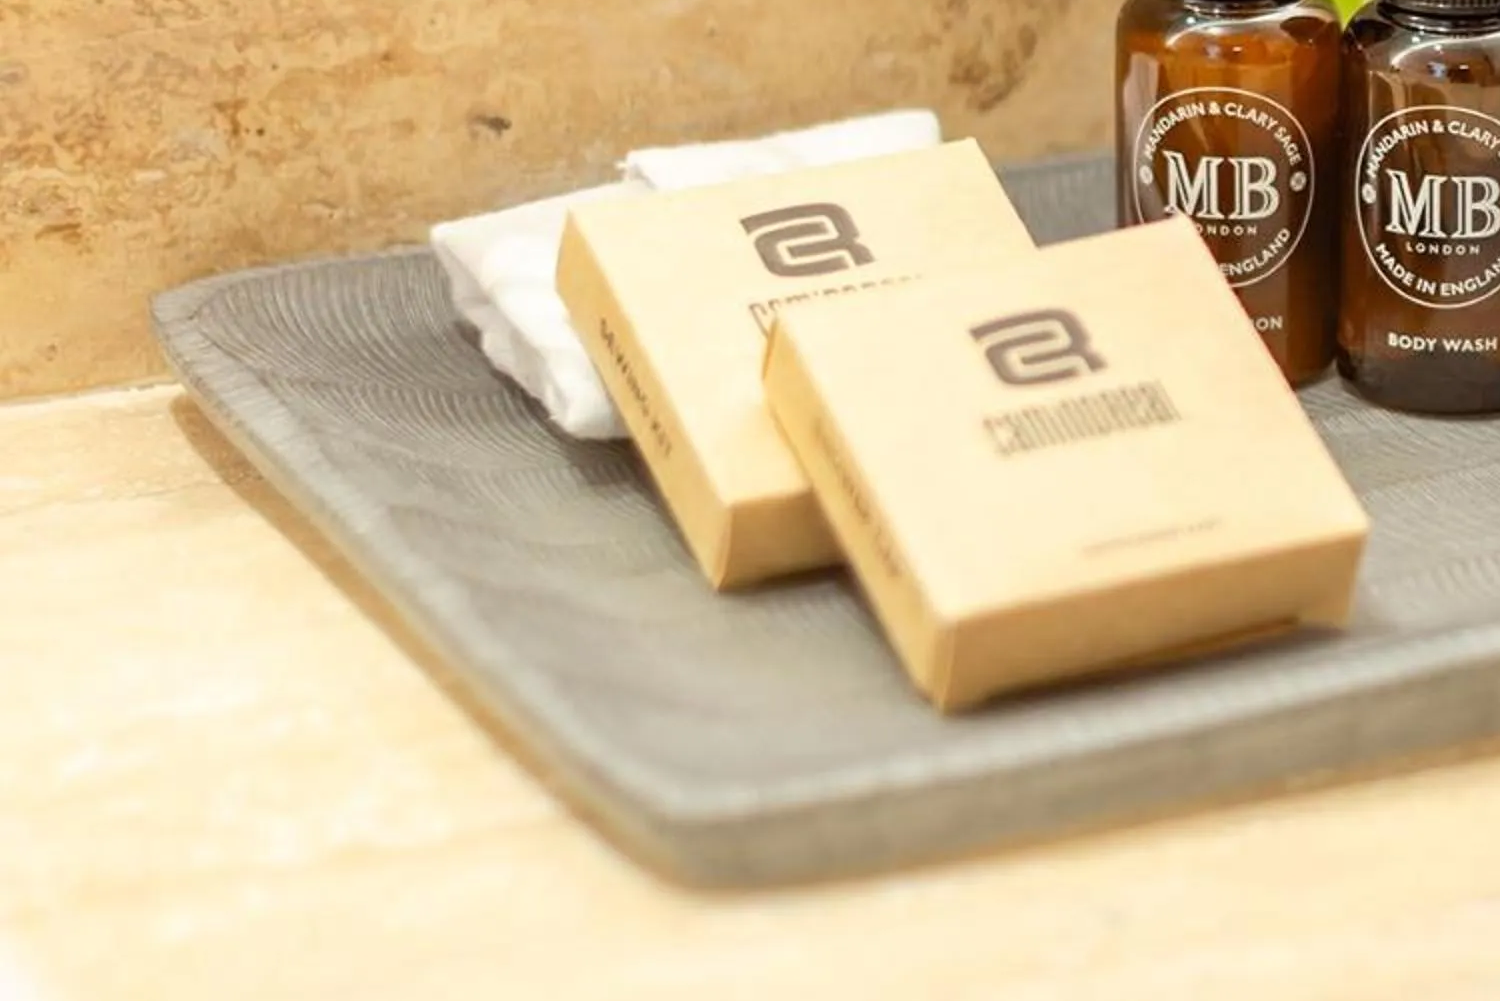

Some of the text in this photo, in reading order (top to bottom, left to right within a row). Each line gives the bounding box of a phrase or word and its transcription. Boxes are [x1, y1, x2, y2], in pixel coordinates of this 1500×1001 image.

[1144, 101, 1302, 166] MANDARIN & CLARY SAGE
[1366, 120, 1429, 178] MANDARIN
[1432, 118, 1445, 133] &
[1447, 120, 1500, 150] CLARY
[1162, 150, 1280, 219] MB
[1195, 222, 1257, 236] ONDON
[1219, 228, 1291, 275] ENGLAND
[1405, 241, 1480, 256] LONDON
[1375, 243, 1417, 287] MADE
[1416, 278, 1436, 295] IN
[1387, 332, 1498, 352] BODY WASH
